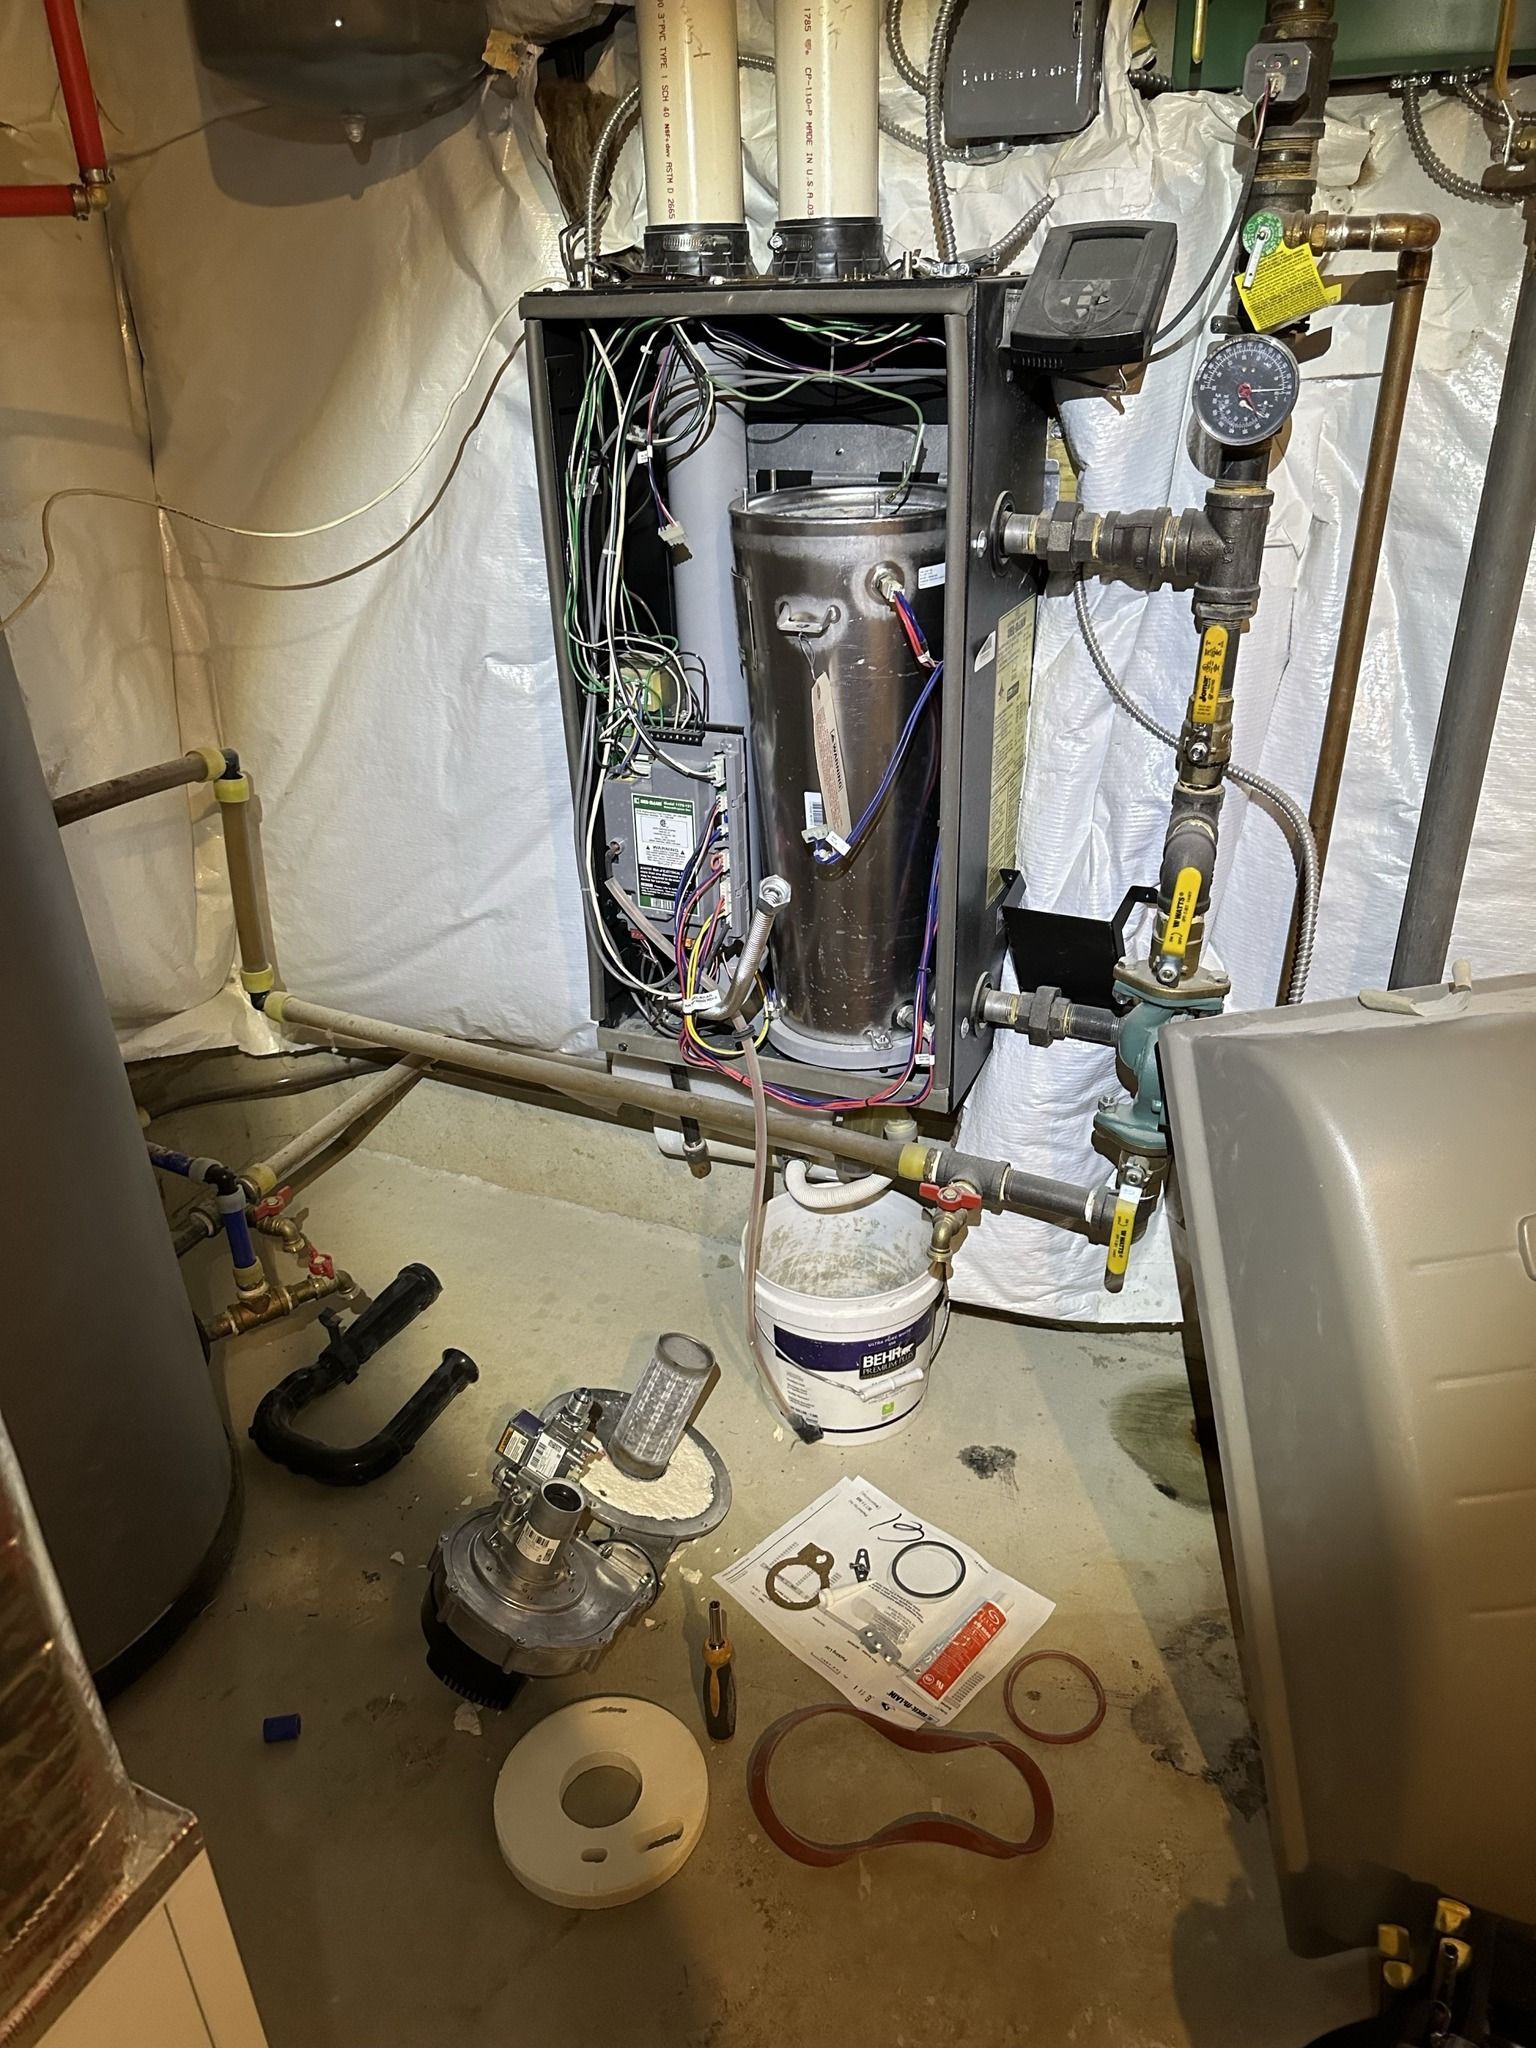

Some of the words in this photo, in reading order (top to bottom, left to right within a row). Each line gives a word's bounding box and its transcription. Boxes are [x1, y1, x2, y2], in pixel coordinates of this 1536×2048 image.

[804, 7, 812, 32] 1785
[660, 47, 668, 69] TYPE
[661, 84, 670, 103] SCH
[805, 67, 813, 116] CP-110-P
[662, 106, 670, 119] 40
[806, 121, 814, 146] MADE
[806, 152, 814, 164] IN
[665, 162, 674, 184] ASTM
[667, 187, 674, 195] D
[667, 198, 676, 221] 2665
[1201, 676, 1211, 703] Jomar
[832, 742, 842, 789] WARNING
[862, 1361, 898, 1376] PREMIUM
[863, 1346, 902, 1369] BEHR
